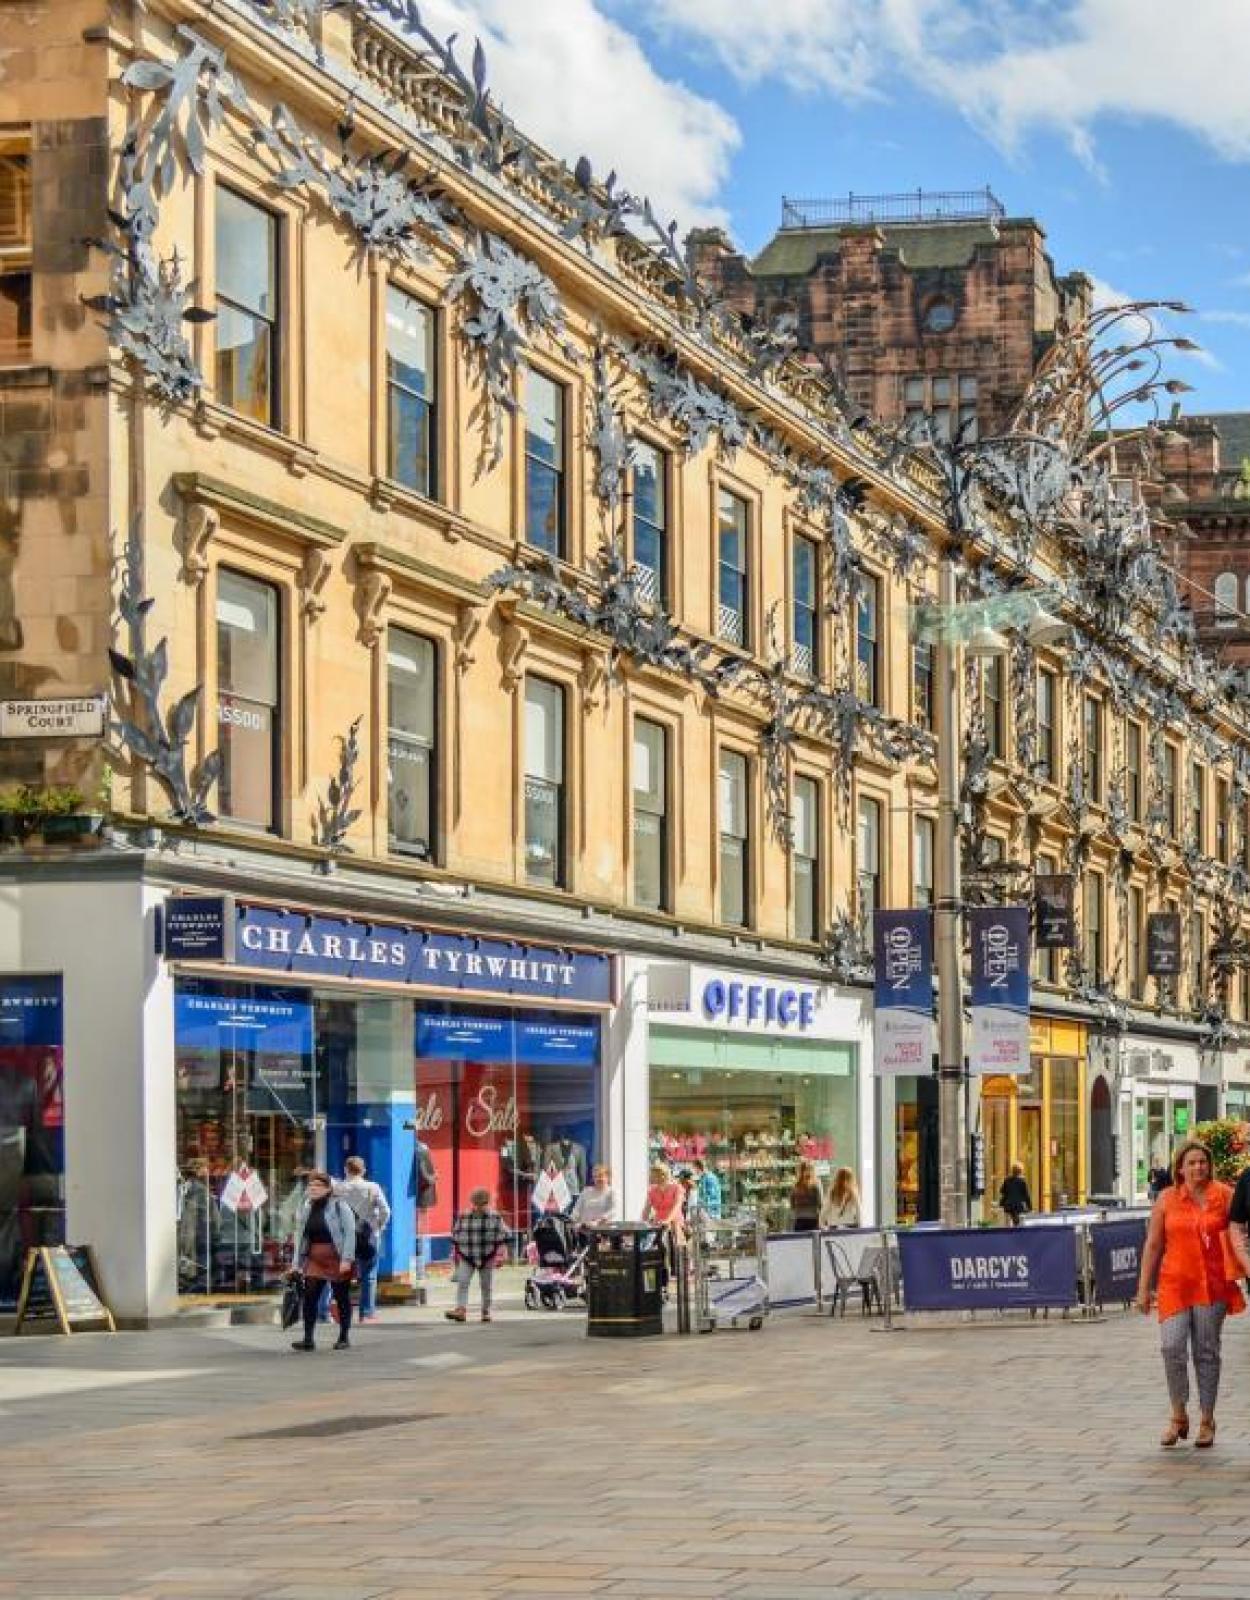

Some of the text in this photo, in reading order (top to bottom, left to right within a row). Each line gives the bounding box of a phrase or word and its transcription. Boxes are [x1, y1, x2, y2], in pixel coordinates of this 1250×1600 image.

[7, 702, 95, 715] SPRINGFIELD
[27, 715, 73, 728] COURT
[242, 924, 407, 966] CHARLES
[423, 948, 576, 985] TYRWHITT
[891, 926, 910, 989] OPEN
[988, 924, 1008, 987] OPEN
[703, 979, 815, 1028] OFFICE
[465, 1085, 520, 1137] Sale
[951, 1255, 1029, 1279] DARCY'S
